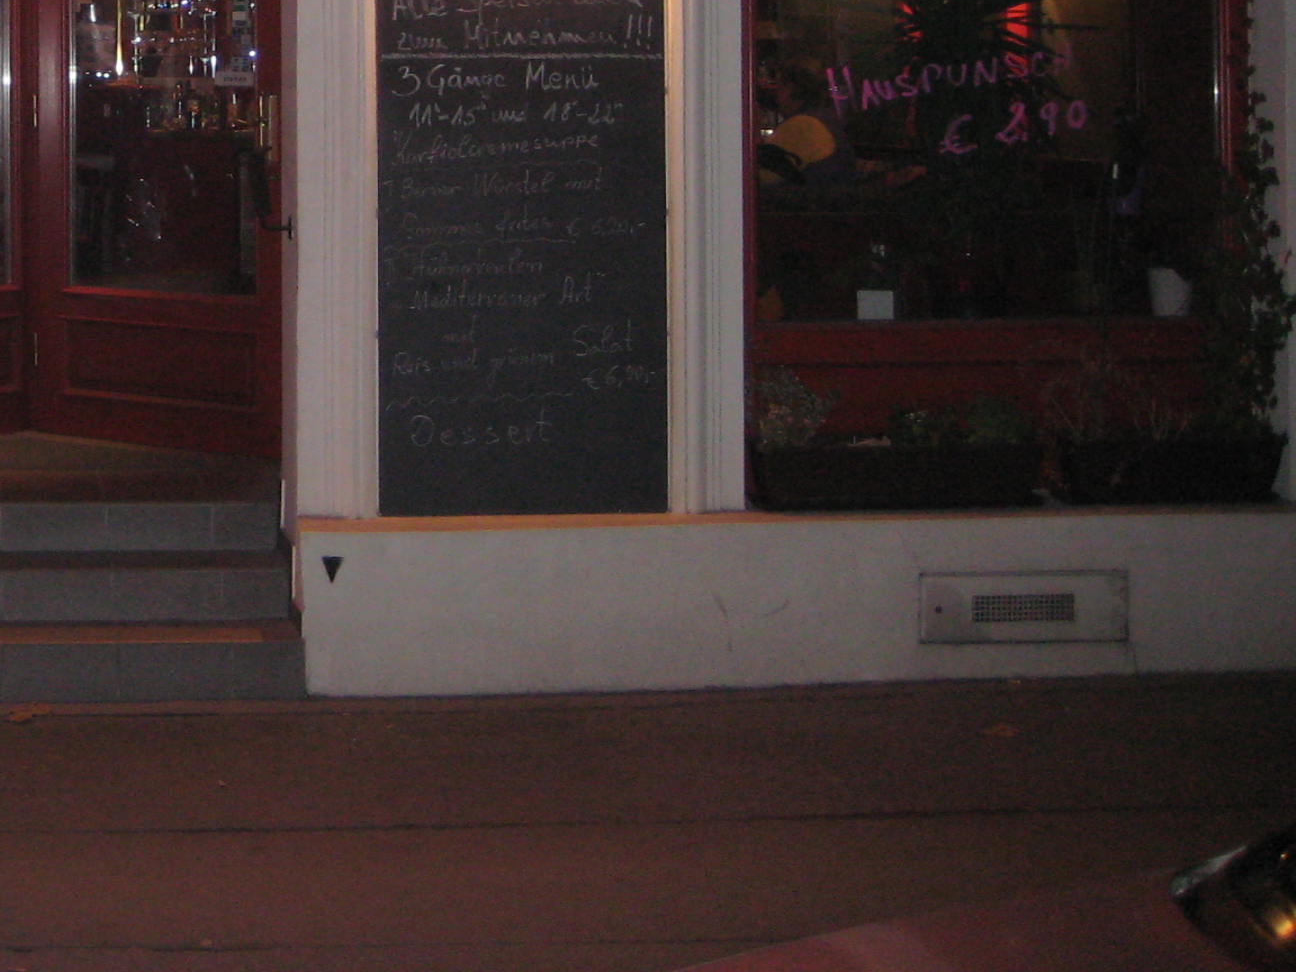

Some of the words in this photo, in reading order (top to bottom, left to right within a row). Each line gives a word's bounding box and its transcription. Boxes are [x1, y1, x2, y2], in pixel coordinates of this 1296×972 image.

[390, 65, 422, 98] 3
[426, 63, 508, 101] Gänge
[525, 60, 600, 92] Menü
